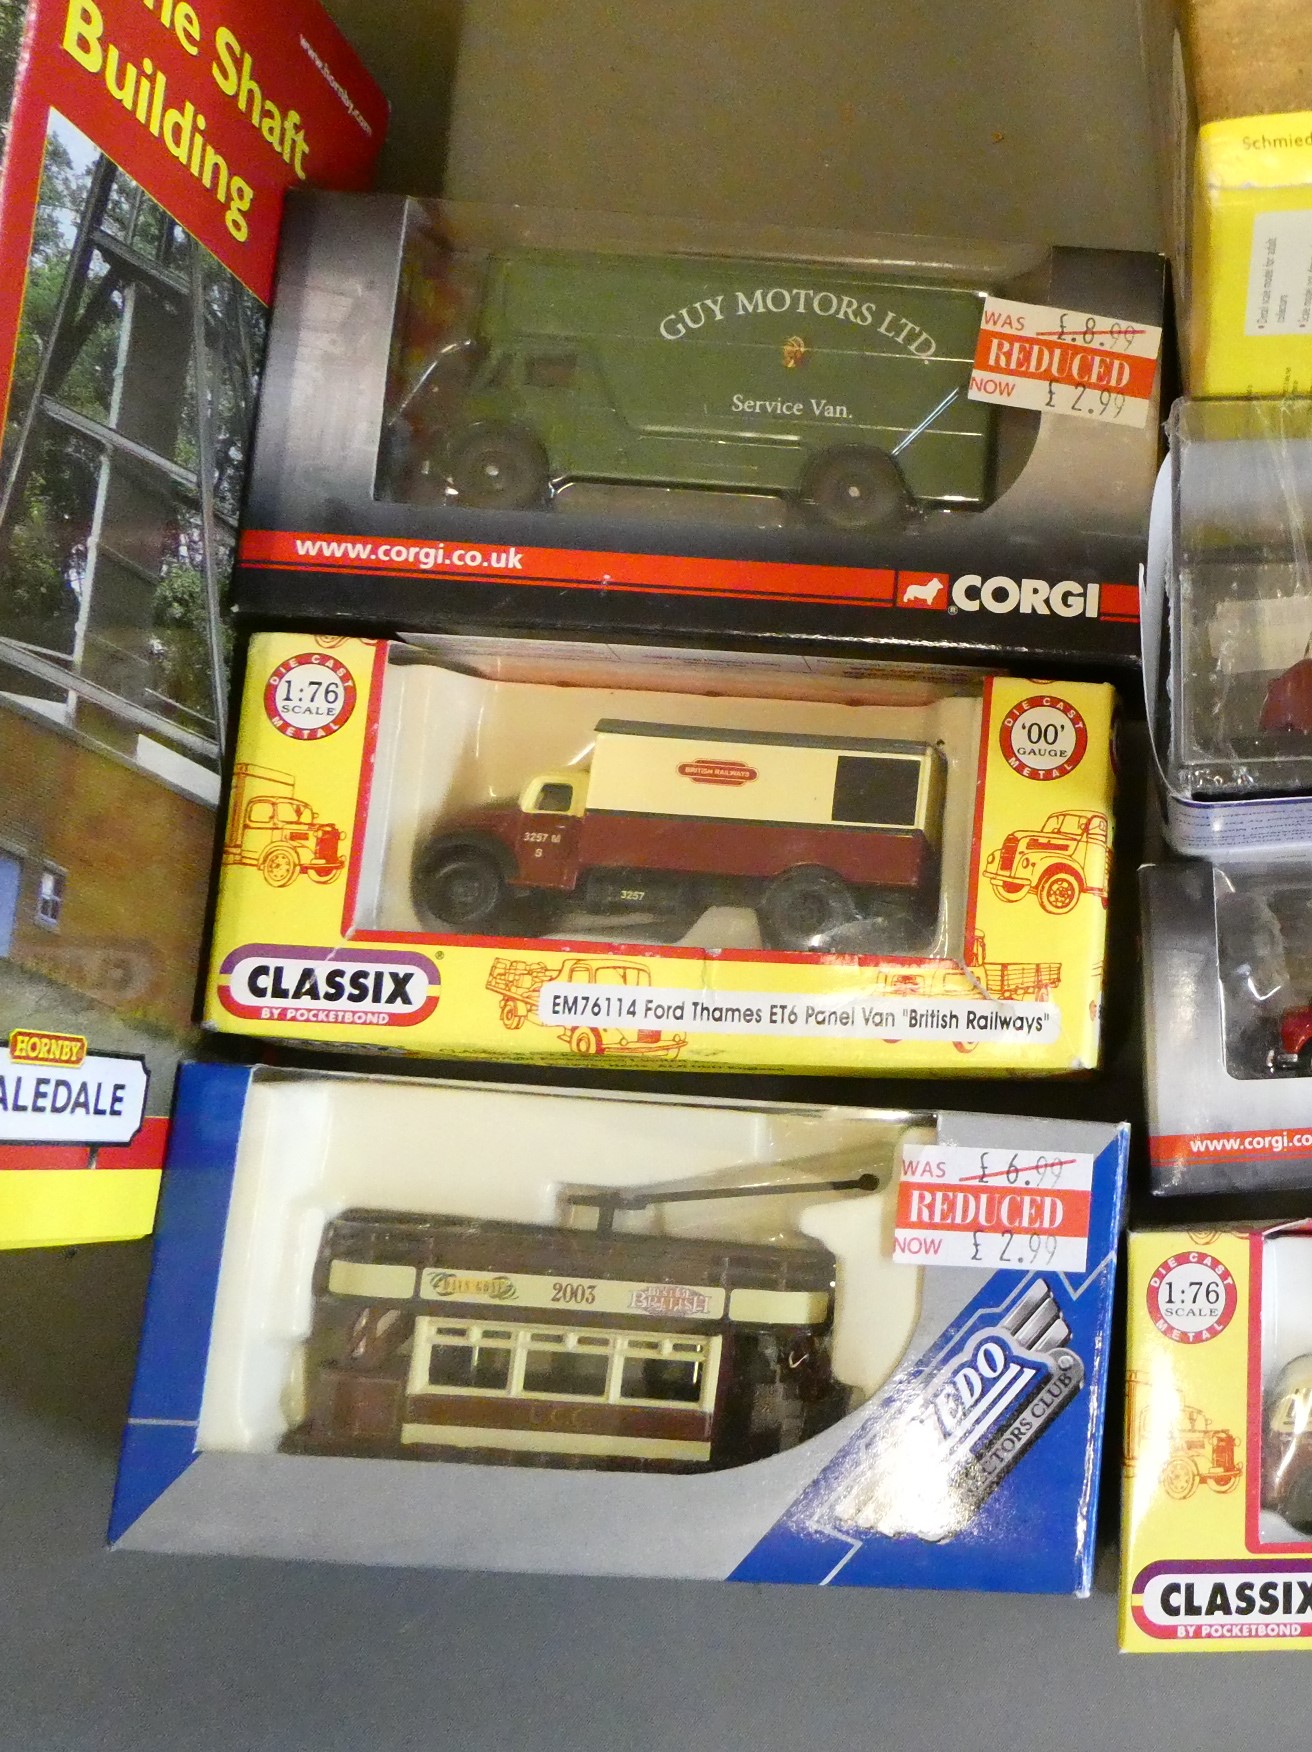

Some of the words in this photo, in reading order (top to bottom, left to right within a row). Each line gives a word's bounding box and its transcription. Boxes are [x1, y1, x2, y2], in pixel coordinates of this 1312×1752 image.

[212, 27, 310, 180] Shaft
[62, 0, 253, 242] Building
[659, 296, 725, 340] GUY
[736, 288, 876, 326] MOTORS
[984, 310, 1026, 332] WAS
[988, 338, 1131, 388] REDUCED
[970, 376, 1016, 398] NOW
[732, 394, 803, 415] Service
[810, 399, 853, 418] Van.
[295, 538, 524, 570] www.corgi.co.uk
[951, 574, 1099, 618] CORGI
[270, 658, 299, 685] DIE
[311, 654, 354, 687] CAST
[282, 680, 340, 704] 1:76
[281, 705, 337, 716] SCALE
[1005, 701, 1031, 727] DIE
[1042, 697, 1083, 728] CAST
[272, 716, 340, 739] METAL
[1017, 747, 1067, 758] GAUGE
[685, 766, 713, 774] BRITISH
[714, 768, 750, 777] RAILWAYS
[1008, 757, 1072, 779] METAL
[523, 831, 548, 842] 3257
[620, 890, 645, 901] 3257
[247, 965, 416, 1006] CLASSIX
[261, 1007, 282, 1020] BY
[286, 1008, 390, 1025] POCKETBOND
[552, 994, 637, 1018] EM76114
[644, 1000, 684, 1021] Ford
[692, 1002, 762, 1024] Thames
[769, 1004, 798, 1025] ET6
[805, 1006, 855, 1026] Panel
[862, 1007, 895, 1028] Van
[902, 1008, 960, 1031] "British
[966, 1010, 1050, 1035] Railways"
[14, 1035, 81, 1061] HORNBY
[902, 1160, 946, 1178] WAS
[909, 1190, 1064, 1229] REDUCED
[894, 1237, 943, 1255] NOW
[1150, 1257, 1178, 1287] DIE
[1189, 1253, 1233, 1285] CAST
[551, 1282, 598, 1304] 2003
[1165, 1281, 1220, 1305] 1:76
[1164, 1308, 1219, 1317] SCALE
[1156, 1319, 1223, 1342] METAL
[1031, 1371, 1073, 1420] CLUB
[1177, 1625, 1197, 1638] BY
[1201, 1623, 1301, 1638] POCKETBOND
